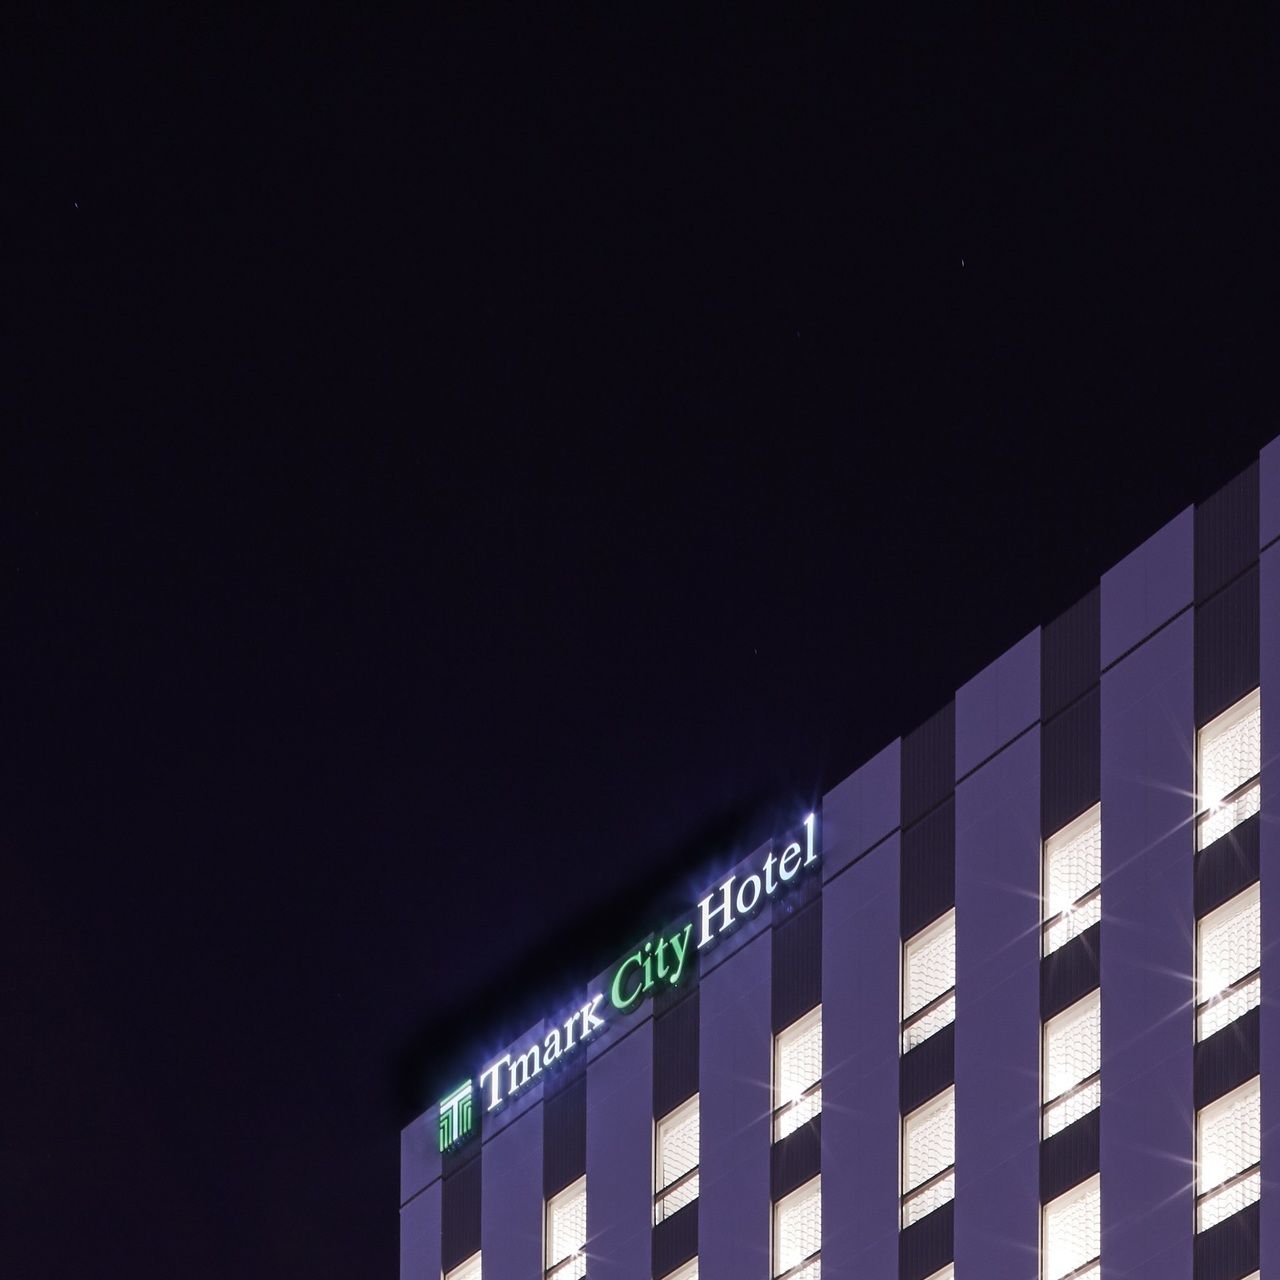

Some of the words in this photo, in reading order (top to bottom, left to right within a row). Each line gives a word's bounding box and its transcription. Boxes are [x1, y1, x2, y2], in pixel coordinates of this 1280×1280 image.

[479, 992, 605, 1112] Tmark
[611, 922, 693, 1010] City
[697, 812, 818, 950] Hotel
